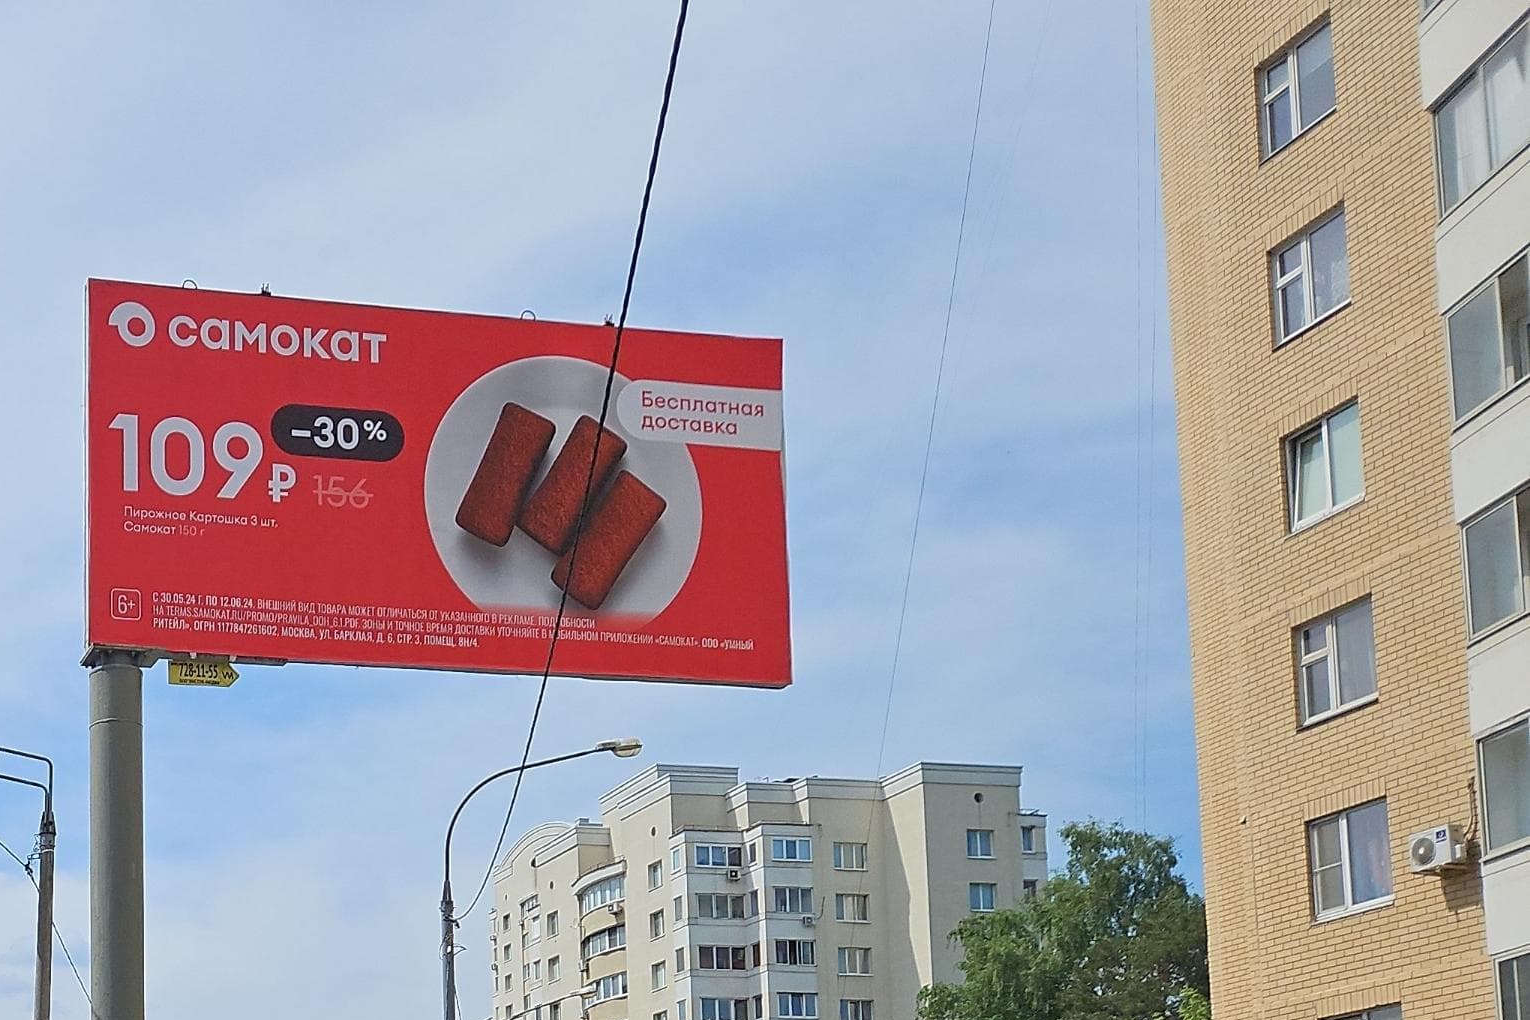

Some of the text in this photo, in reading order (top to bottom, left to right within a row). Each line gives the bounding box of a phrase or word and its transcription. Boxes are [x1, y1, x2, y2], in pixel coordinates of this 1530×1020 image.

[168, 315, 388, 364] самокат
[641, 390, 765, 418] Бесплатная
[641, 414, 739, 436] доставка
[313, 473, 374, 509] 156
[123, 520, 177, 536] Самокат
[178, 524, 198, 536] 150
[124, 505, 187, 522] Пирожное
[189, 510, 249, 526] Картошка
[250, 515, 258, 526] 3
[118, 594, 136, 614] 6+
[160, 592, 196, 604] 30.05.24
[205, 595, 218, 606] ПО
[257, 598, 296, 611] ВНЕШНИЙ
[298, 602, 316, 614] ВИД
[318, 603, 347, 615] ТОВАРА
[348, 605, 375, 617] МОЖЕТ
[377, 606, 428, 619] ОТЛИЧАТЬСЯ
[429, 609, 438, 620] ОТ
[440, 610, 490, 623] УКАЗАННОГО
[491, 613, 497, 624] В
[539, 616, 596, 629] ПОДОБНОСТИ
[152, 604, 164, 616] НА
[362, 617, 386, 630] ЗОНЫ
[387, 619, 392, 630] И
[394, 620, 424, 632] ТОЧНОЕ
[426, 621, 453, 633] ВРЕМЯ
[454, 623, 497, 636] ДОСТАВКИ
[497, 625, 540, 639] УТОЧНЯЙТЕ
[541, 628, 547, 639] В
[600, 632, 654, 645] ПРИЛОЖЕНИИ
[702, 638, 719, 649] ООО
[194, 620, 215, 632] ОГРН
